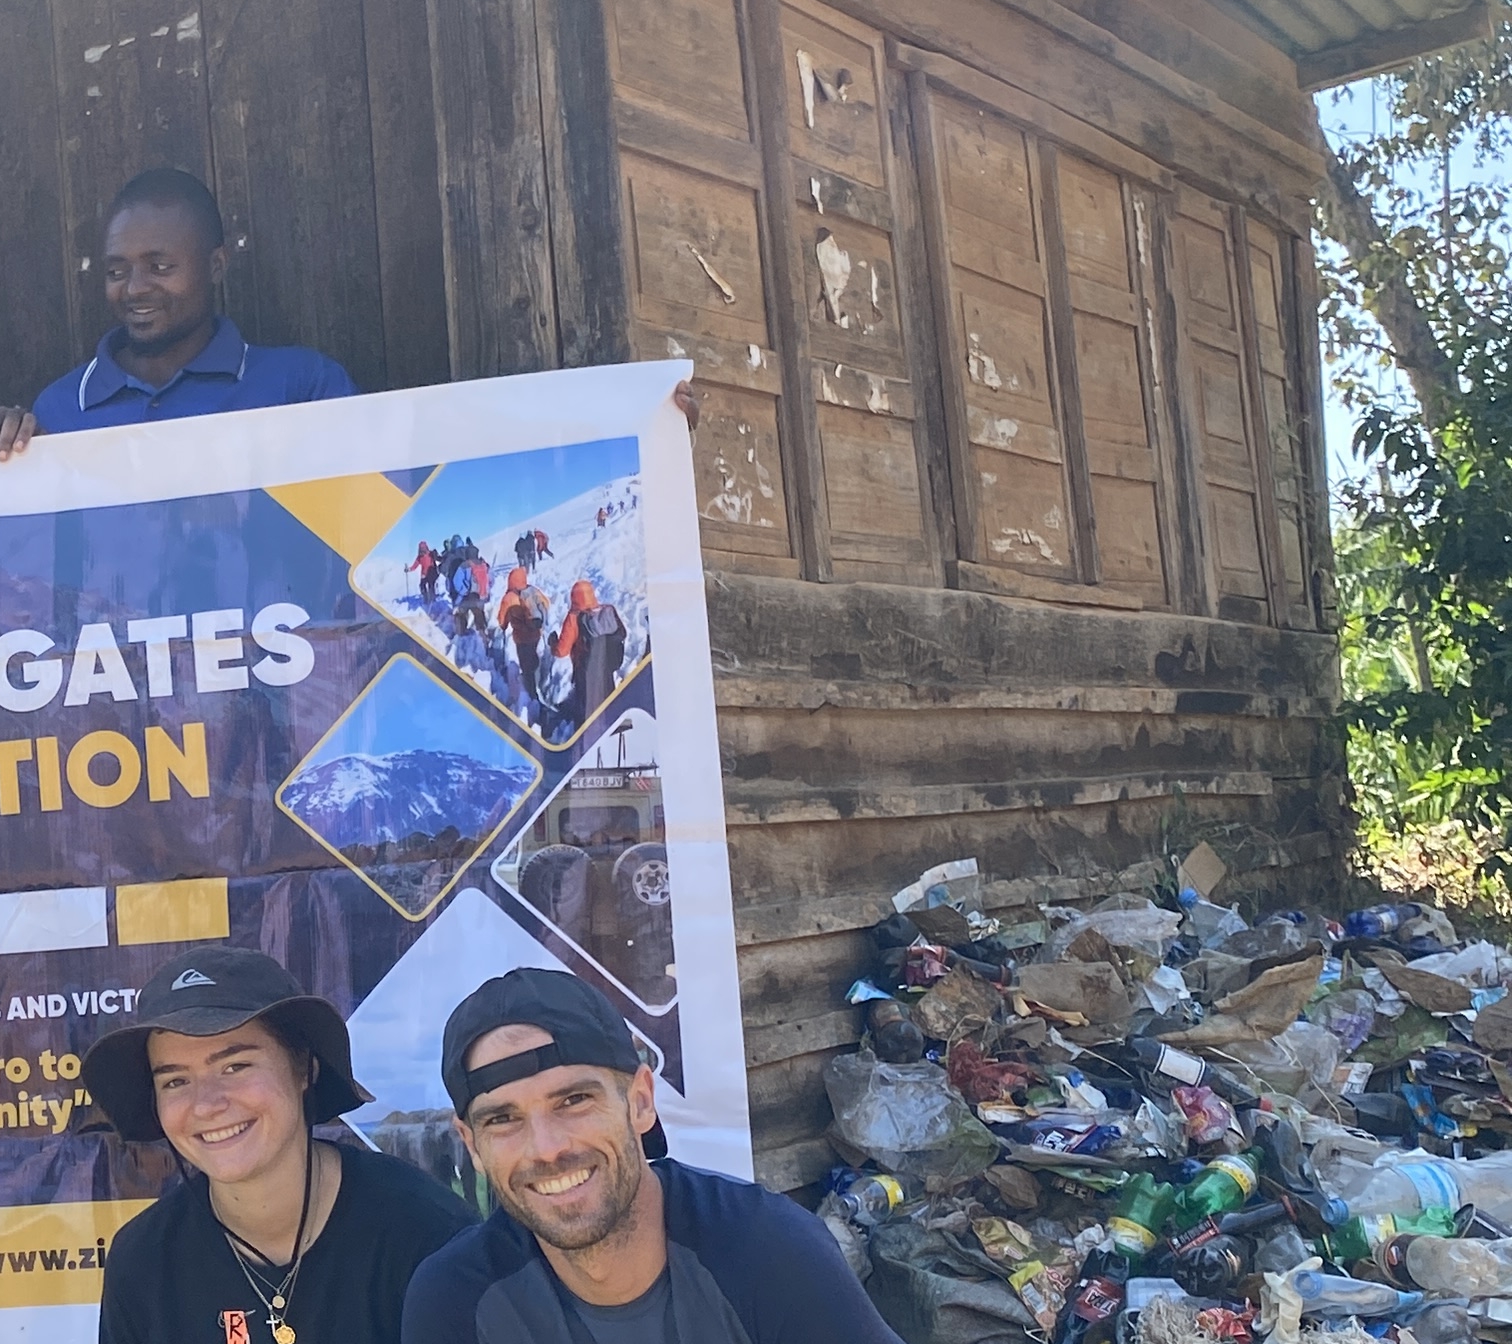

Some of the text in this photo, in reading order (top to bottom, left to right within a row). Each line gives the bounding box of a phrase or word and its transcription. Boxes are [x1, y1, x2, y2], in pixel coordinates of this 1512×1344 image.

[6, 992, 67, 1020] AND
[71, 988, 142, 1016] VICT
[39, 1049, 81, 1081] to
